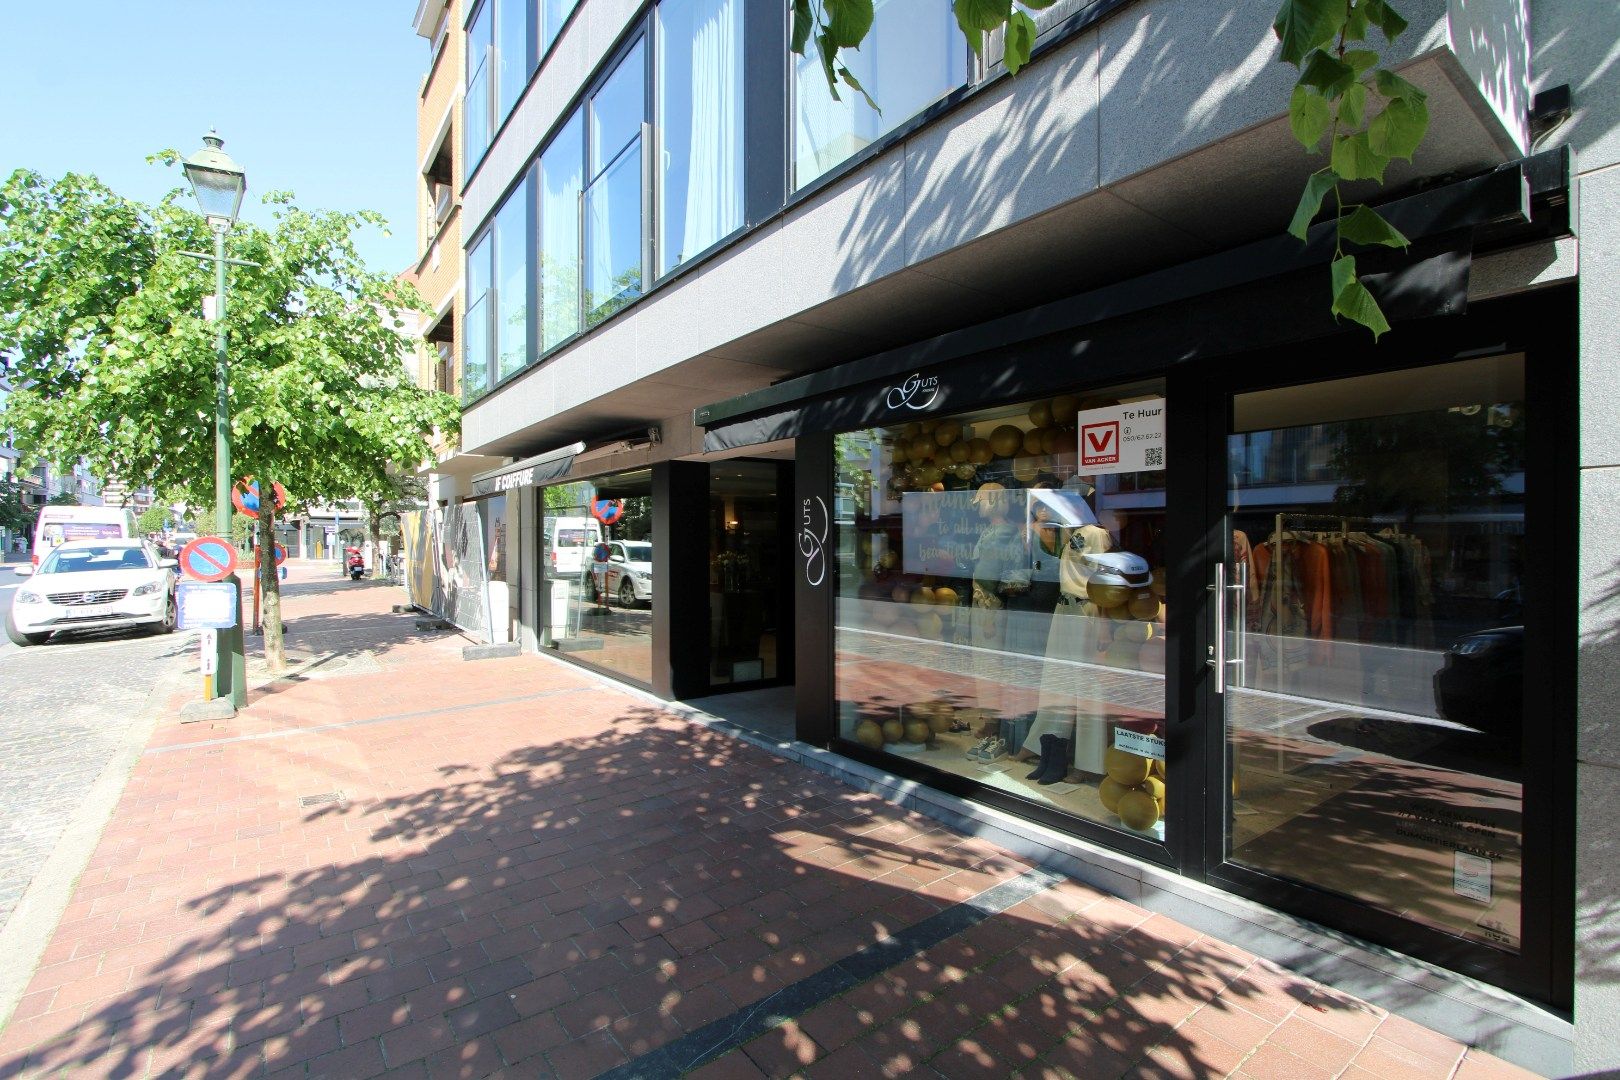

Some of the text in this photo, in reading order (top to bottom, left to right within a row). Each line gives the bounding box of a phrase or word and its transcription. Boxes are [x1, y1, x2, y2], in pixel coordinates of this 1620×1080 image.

[1123, 408, 1162, 420] Te Huur
[502, 467, 534, 489] COIFFURE
[1116, 730, 1166, 747] LAATSTE STUK
[1466, 826, 1496, 838] OPEN
